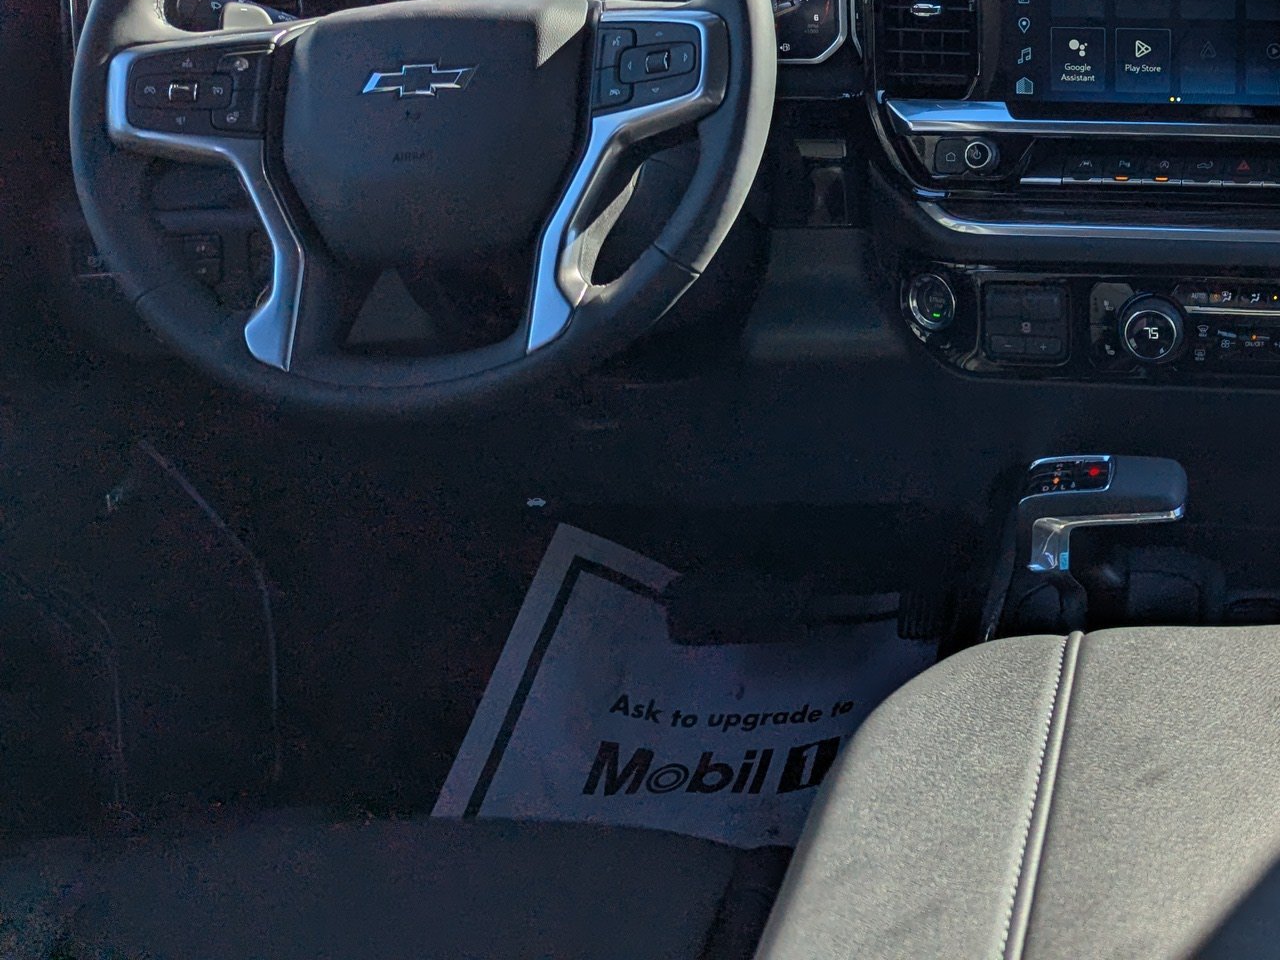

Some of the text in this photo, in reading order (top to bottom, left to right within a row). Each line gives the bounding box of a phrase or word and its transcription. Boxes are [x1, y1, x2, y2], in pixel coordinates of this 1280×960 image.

[1064, 63, 1092, 73] Google
[1124, 64, 1162, 74] Play Store
[1060, 73, 1095, 82] Assistant
[609, 694, 854, 732] Ask to upgrade to
[582, 740, 774, 797] Mobil
